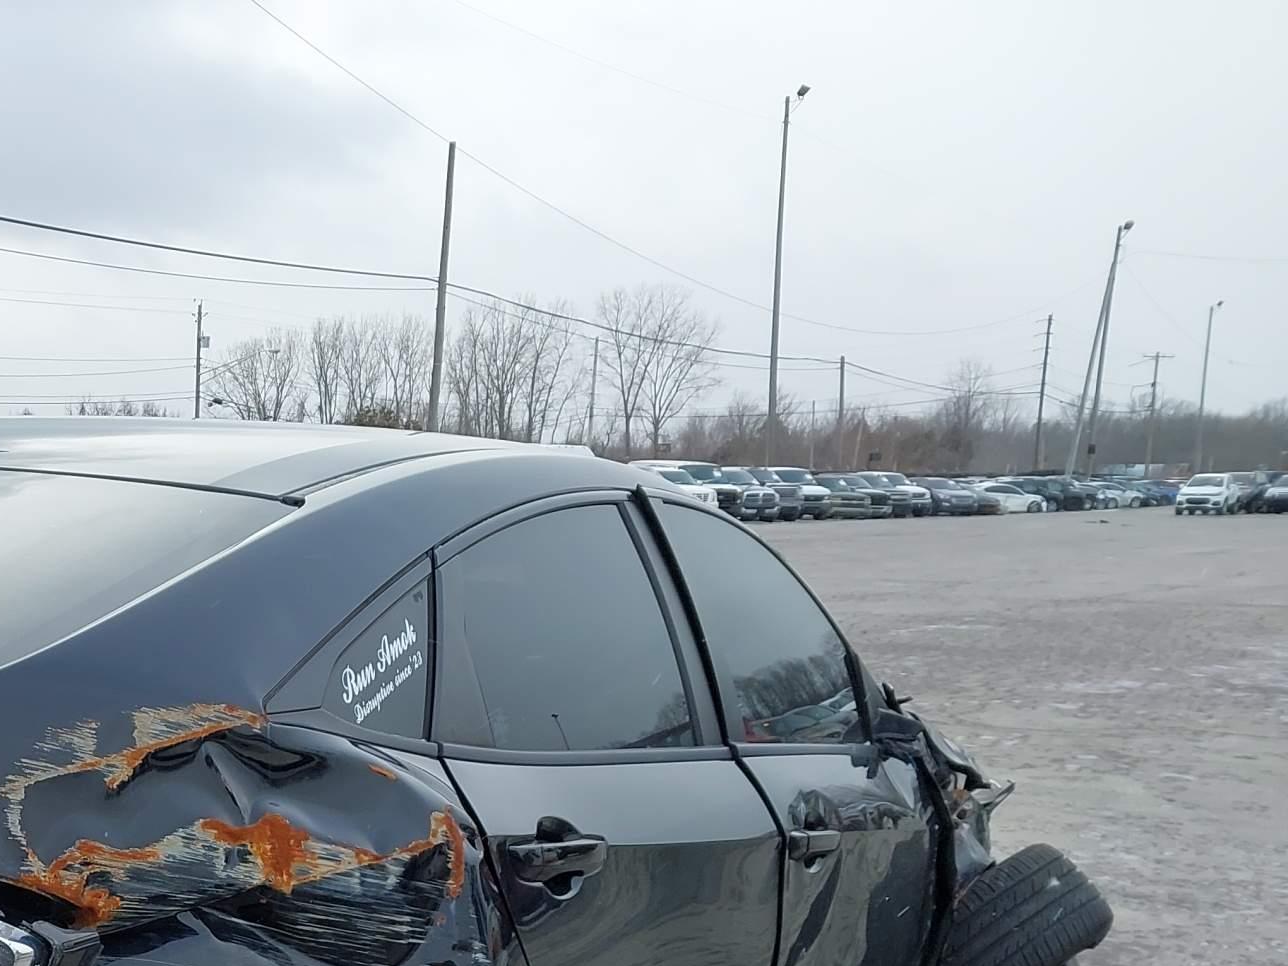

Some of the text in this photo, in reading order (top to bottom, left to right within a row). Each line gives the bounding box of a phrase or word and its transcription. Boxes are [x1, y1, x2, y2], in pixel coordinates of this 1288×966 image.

[341, 617, 416, 704] Run Amok
[354, 680, 394, 724] Disruptive
[395, 663, 413, 687] since
